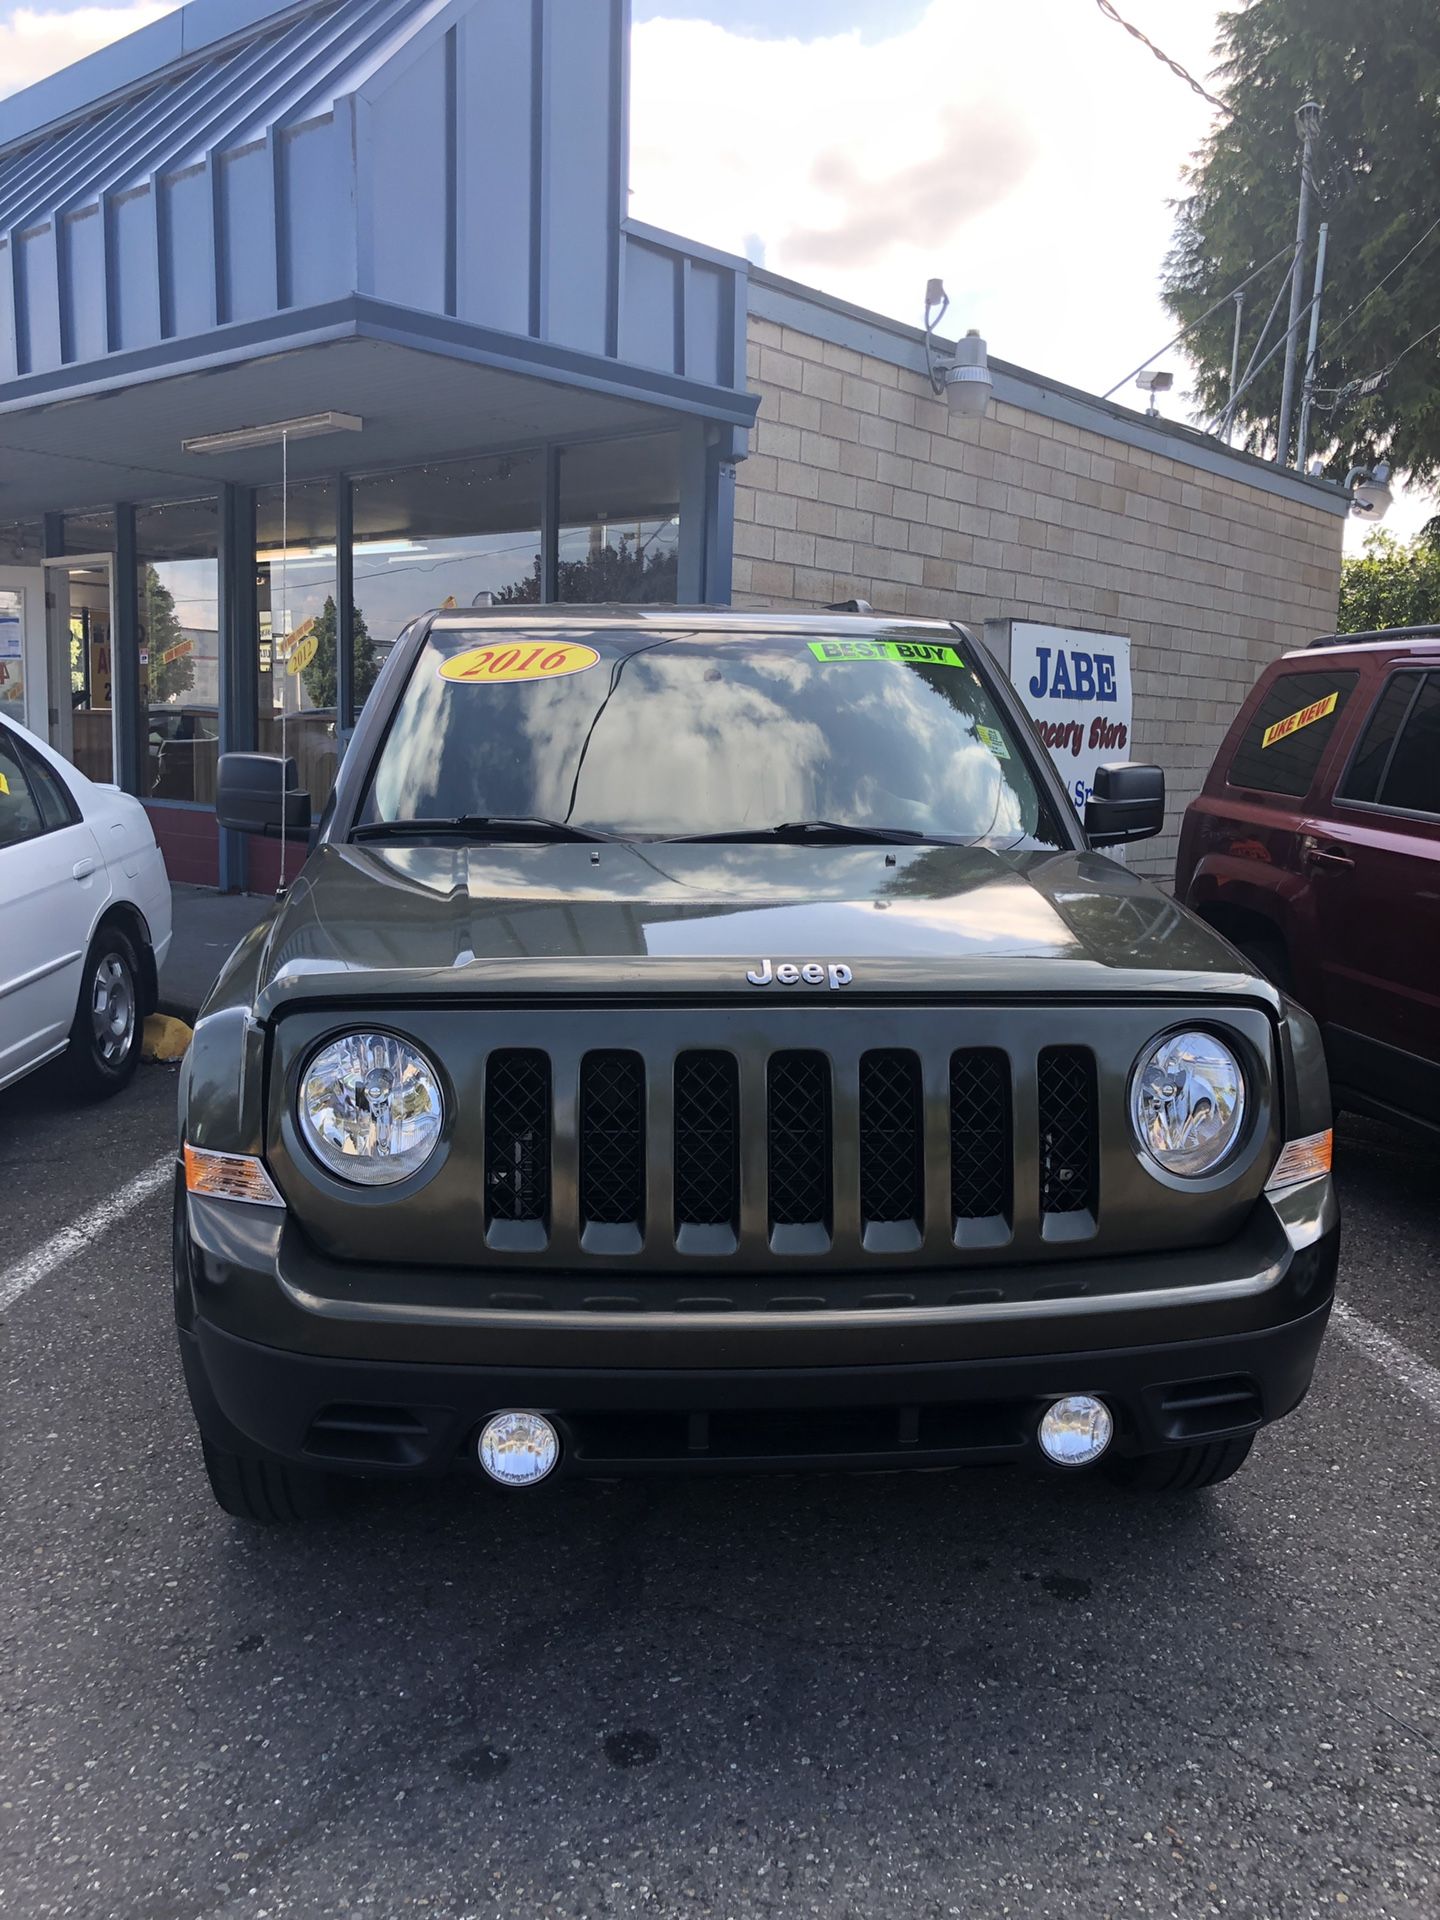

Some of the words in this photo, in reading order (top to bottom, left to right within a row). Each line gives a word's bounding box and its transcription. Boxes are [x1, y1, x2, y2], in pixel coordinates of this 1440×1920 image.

[458, 647, 577, 678] 2016
[820, 643, 889, 658] BEST
[895, 644, 945, 661] BUY
[1029, 647, 1117, 702] JABE
[1088, 716, 1127, 750] Store
[1266, 715, 1297, 743] LIKE
[1297, 697, 1331, 727] NEW
[746, 959, 853, 989] Jeep
